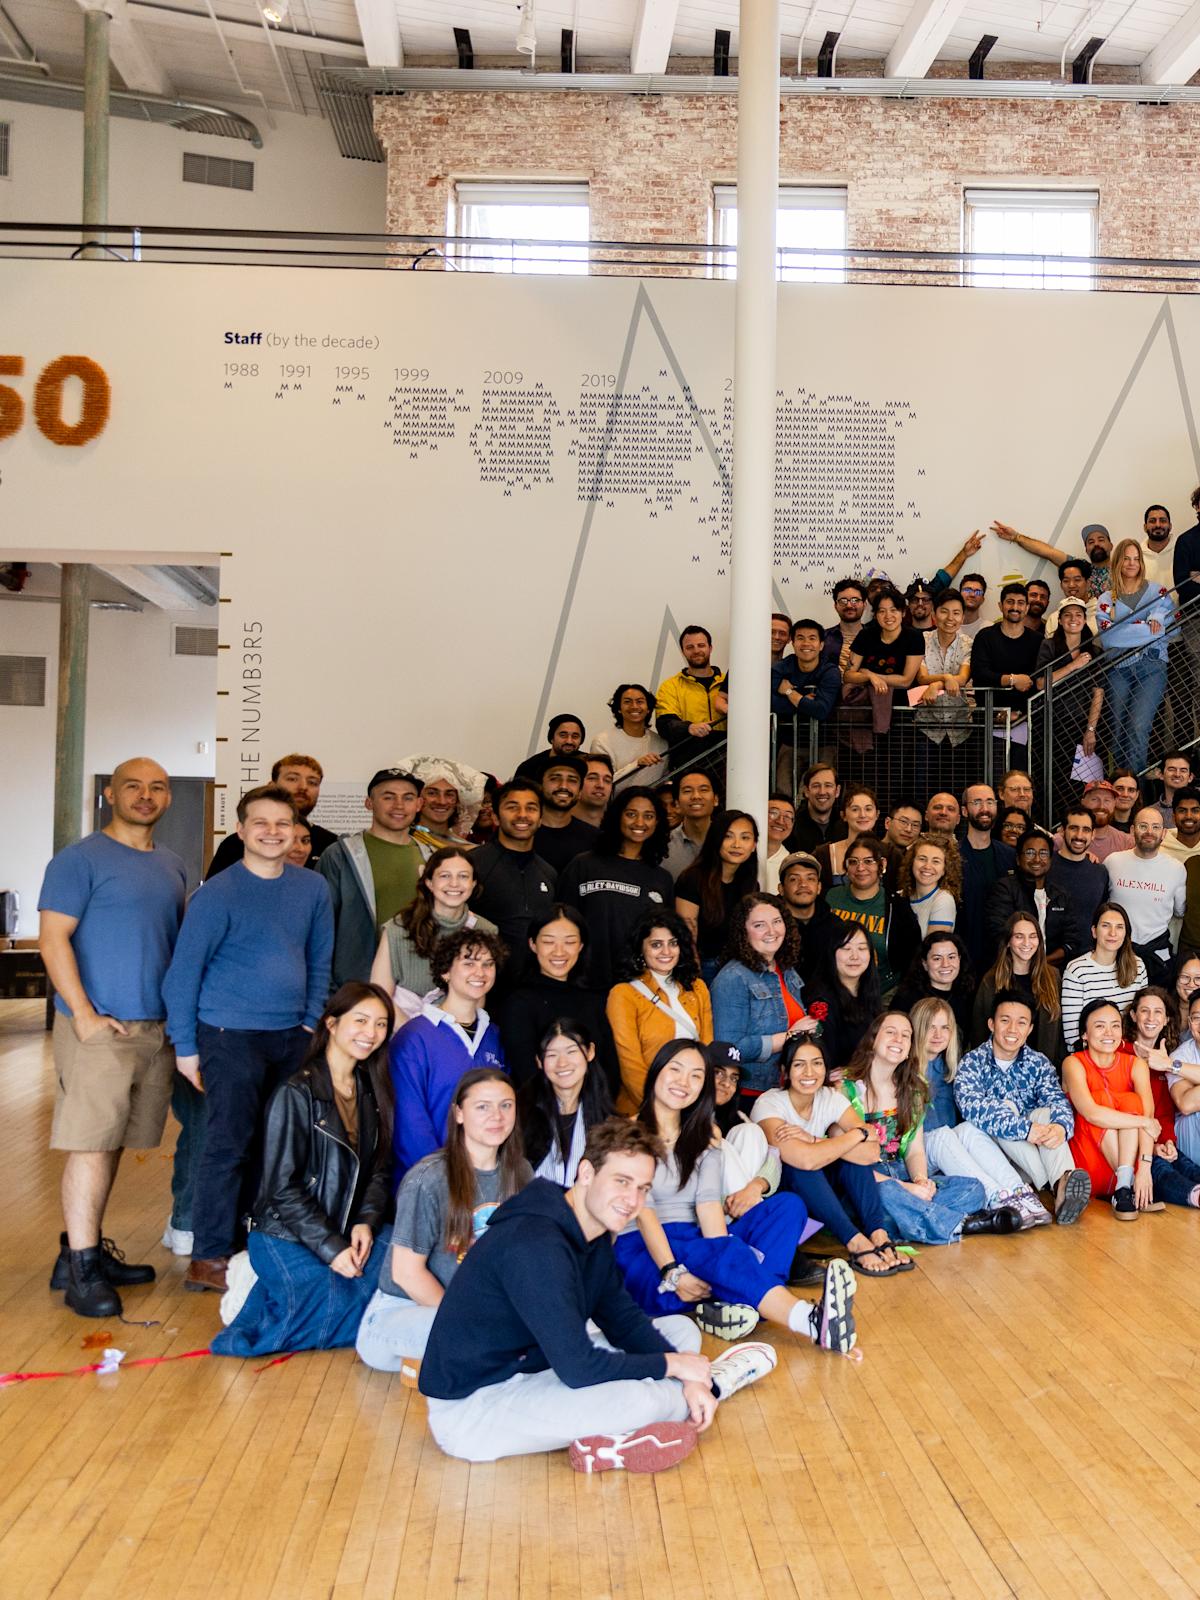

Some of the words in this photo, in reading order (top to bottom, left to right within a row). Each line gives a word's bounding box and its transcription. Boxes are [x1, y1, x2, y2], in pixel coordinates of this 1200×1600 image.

[224, 332, 262, 345] Staff
[266, 333, 290, 348] (by
[295, 334, 317, 347] the
[321, 335, 380, 350] decade)
[224, 363, 260, 377] 1988
[280, 364, 312, 378] 1991
[335, 366, 370, 380] 1995
[394, 368, 430, 381] 1999
[483, 371, 524, 384] 2009
[580, 374, 616, 387] 2019
[242, 621, 263, 742] NUMB3R5
